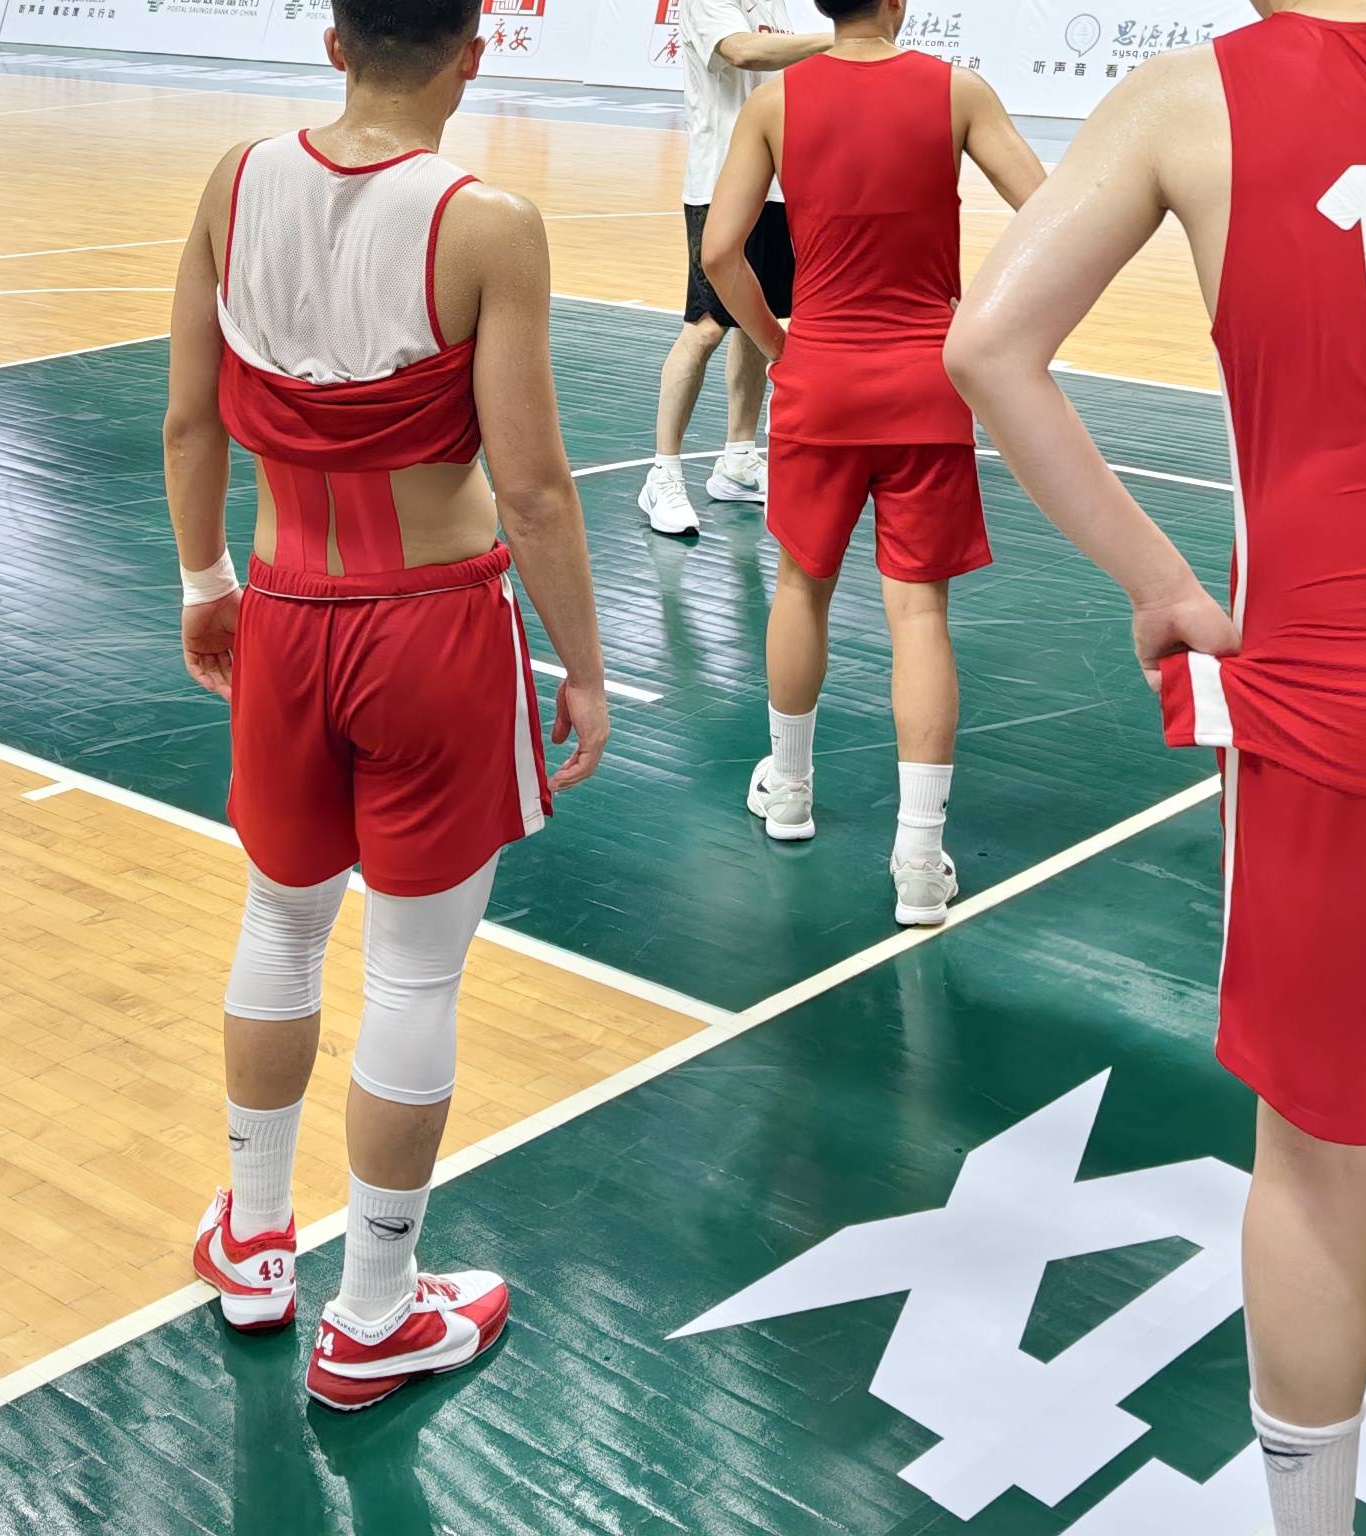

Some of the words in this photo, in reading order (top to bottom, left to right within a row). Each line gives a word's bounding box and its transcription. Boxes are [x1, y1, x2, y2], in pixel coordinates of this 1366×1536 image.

[1032, 60, 1087, 76] 听声音
[258, 1257, 284, 1282] 43
